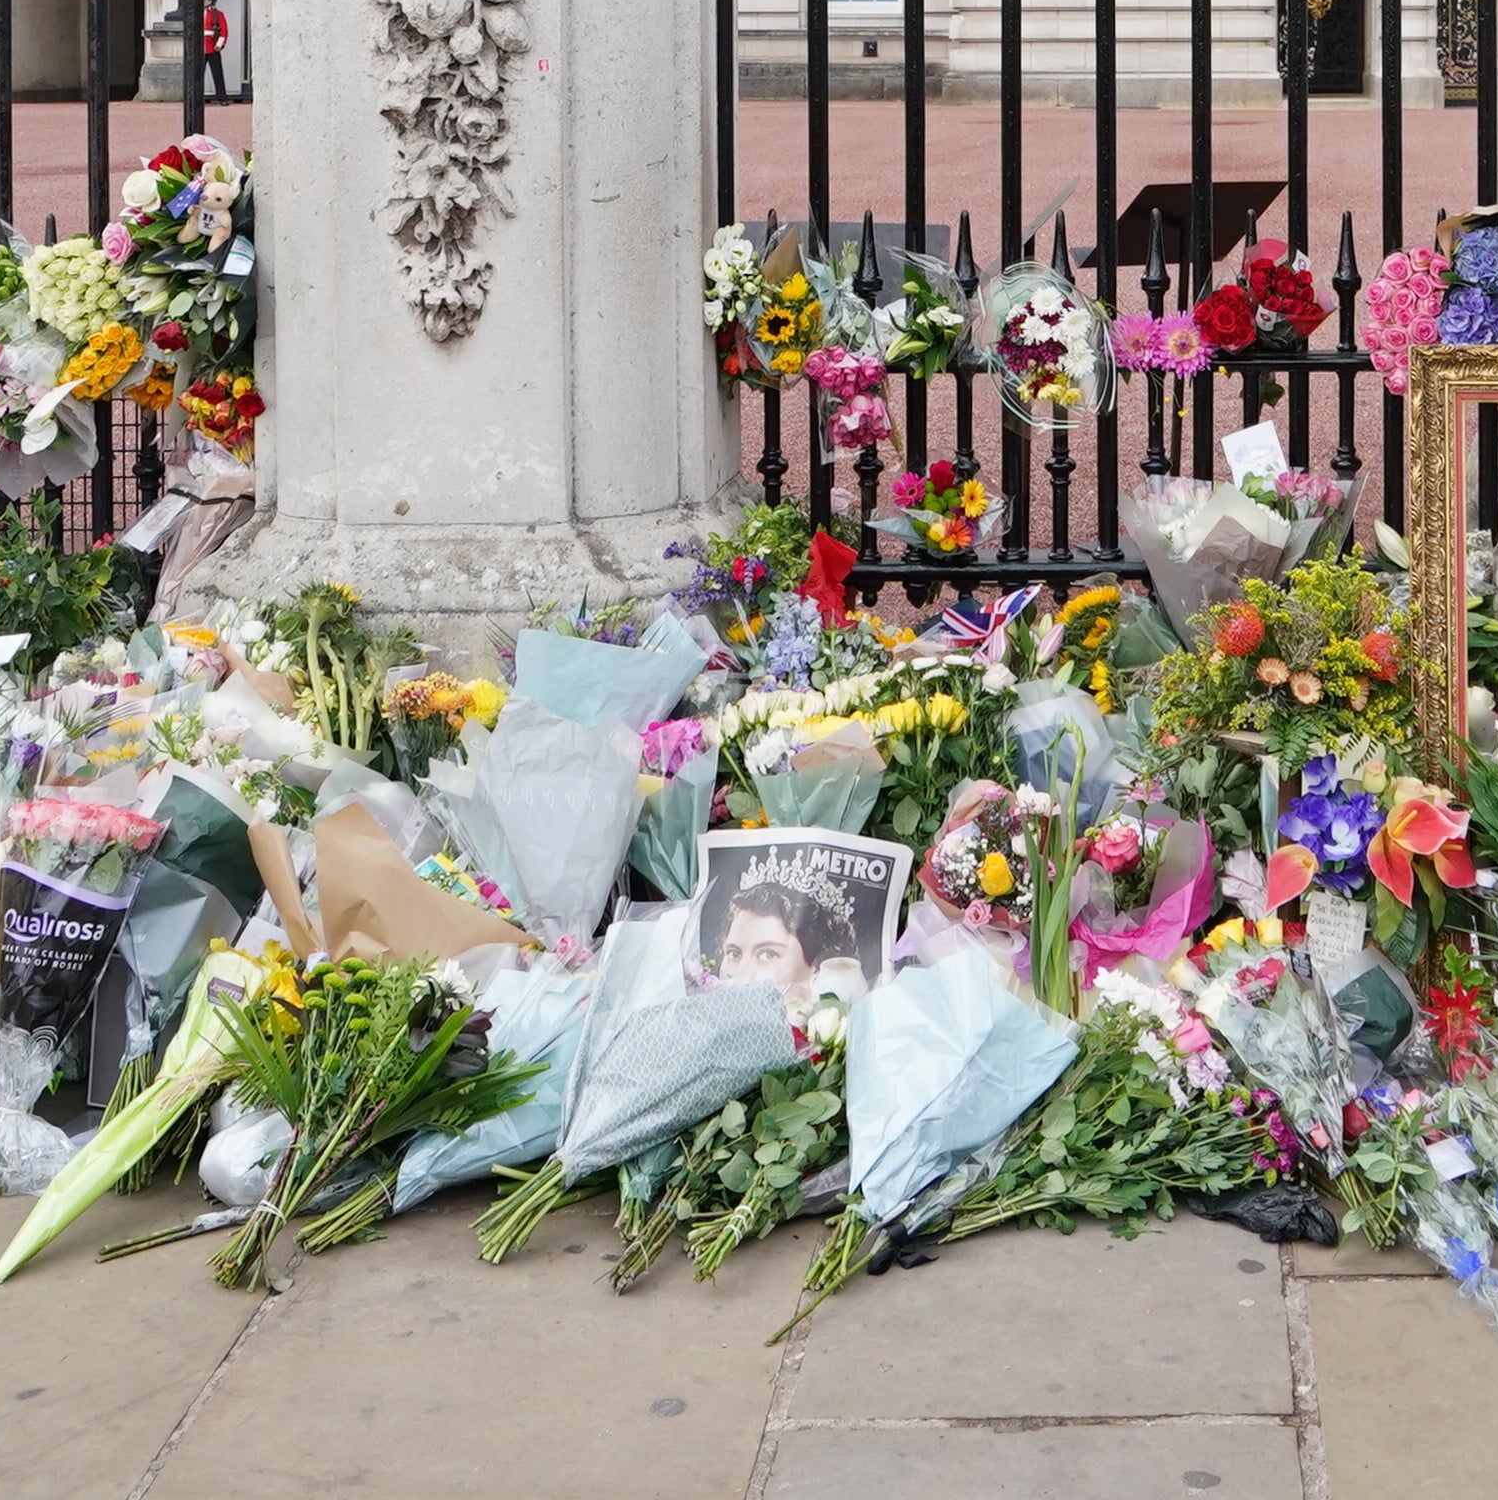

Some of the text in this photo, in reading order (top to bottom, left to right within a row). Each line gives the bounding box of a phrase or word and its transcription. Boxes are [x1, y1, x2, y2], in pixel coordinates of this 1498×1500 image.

[810, 848, 888, 882] METRO
[3, 908, 105, 942] Qualirosa
[4, 954, 84, 971] BRAND OF ROSES
[23, 946, 38, 956] THE
[41, 949, 94, 960] CELEBRITY
